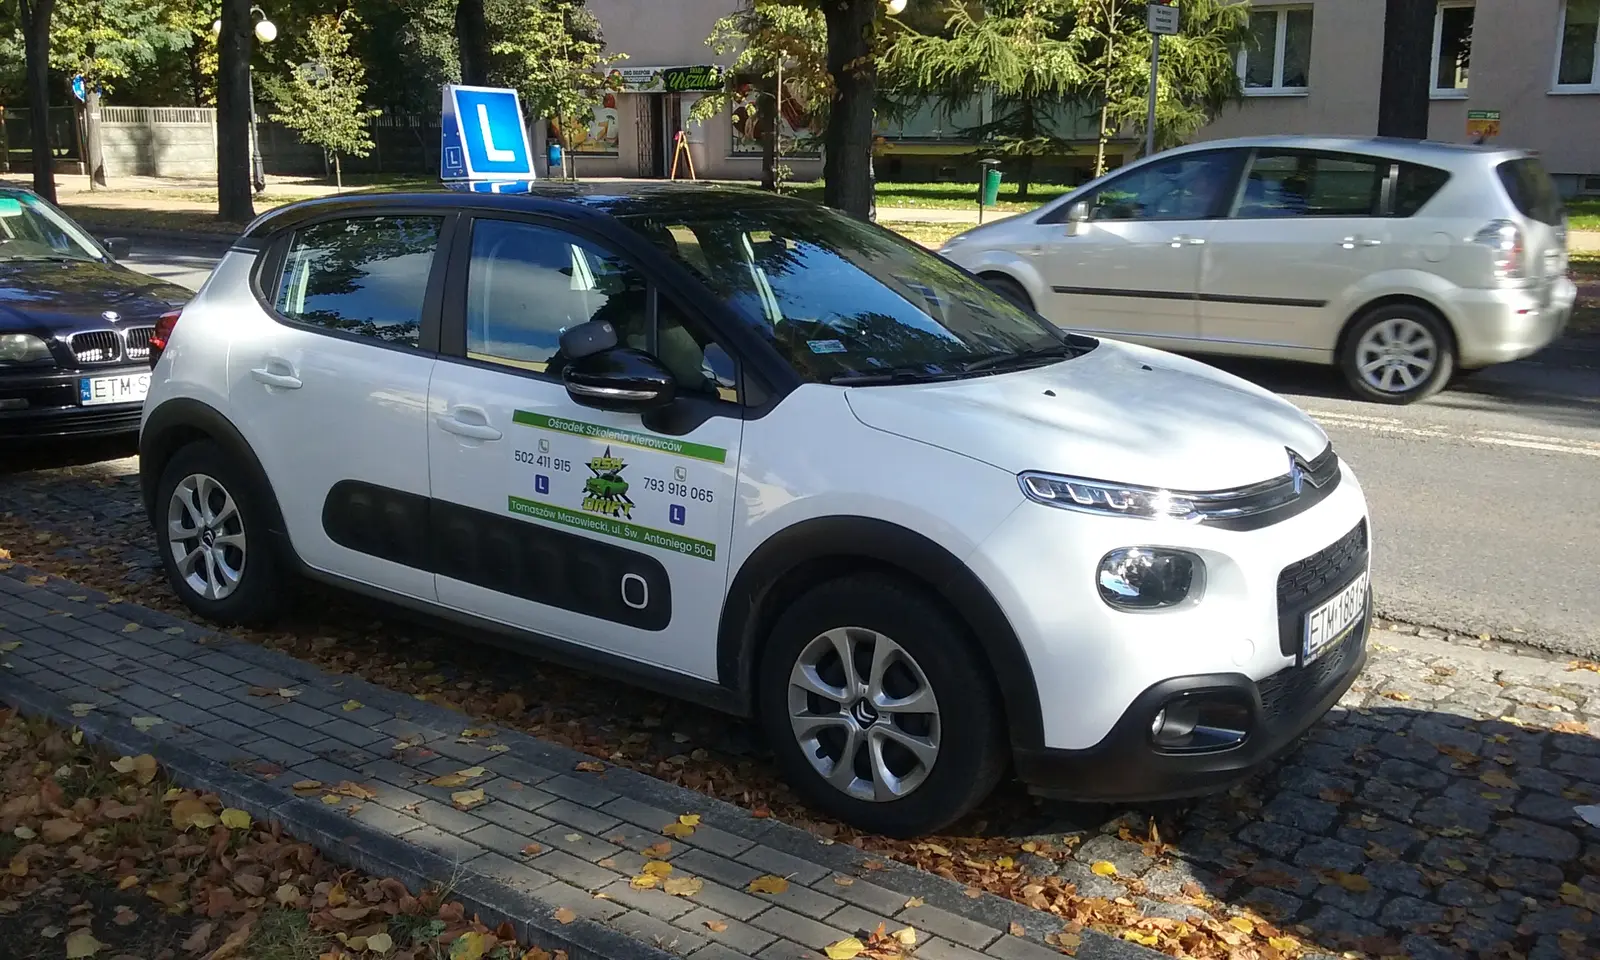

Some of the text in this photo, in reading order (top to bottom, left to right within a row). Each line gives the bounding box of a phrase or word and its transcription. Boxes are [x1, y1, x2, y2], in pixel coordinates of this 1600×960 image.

[476, 103, 516, 162] L
[450, 151, 458, 164] L
[94, 377, 131, 398] ETM
[548, 418, 682, 452] Ośrodek Szkolenia Kierowców
[515, 450, 571, 472] 502 411 915
[643, 477, 713, 503] 793 918 065
[582, 497, 633, 517] DRIFT
[511, 500, 713, 557] Tomaszów Mazowiecki, ul. Św. Antoniego 50a
[1310, 602, 1335, 649] ETM
